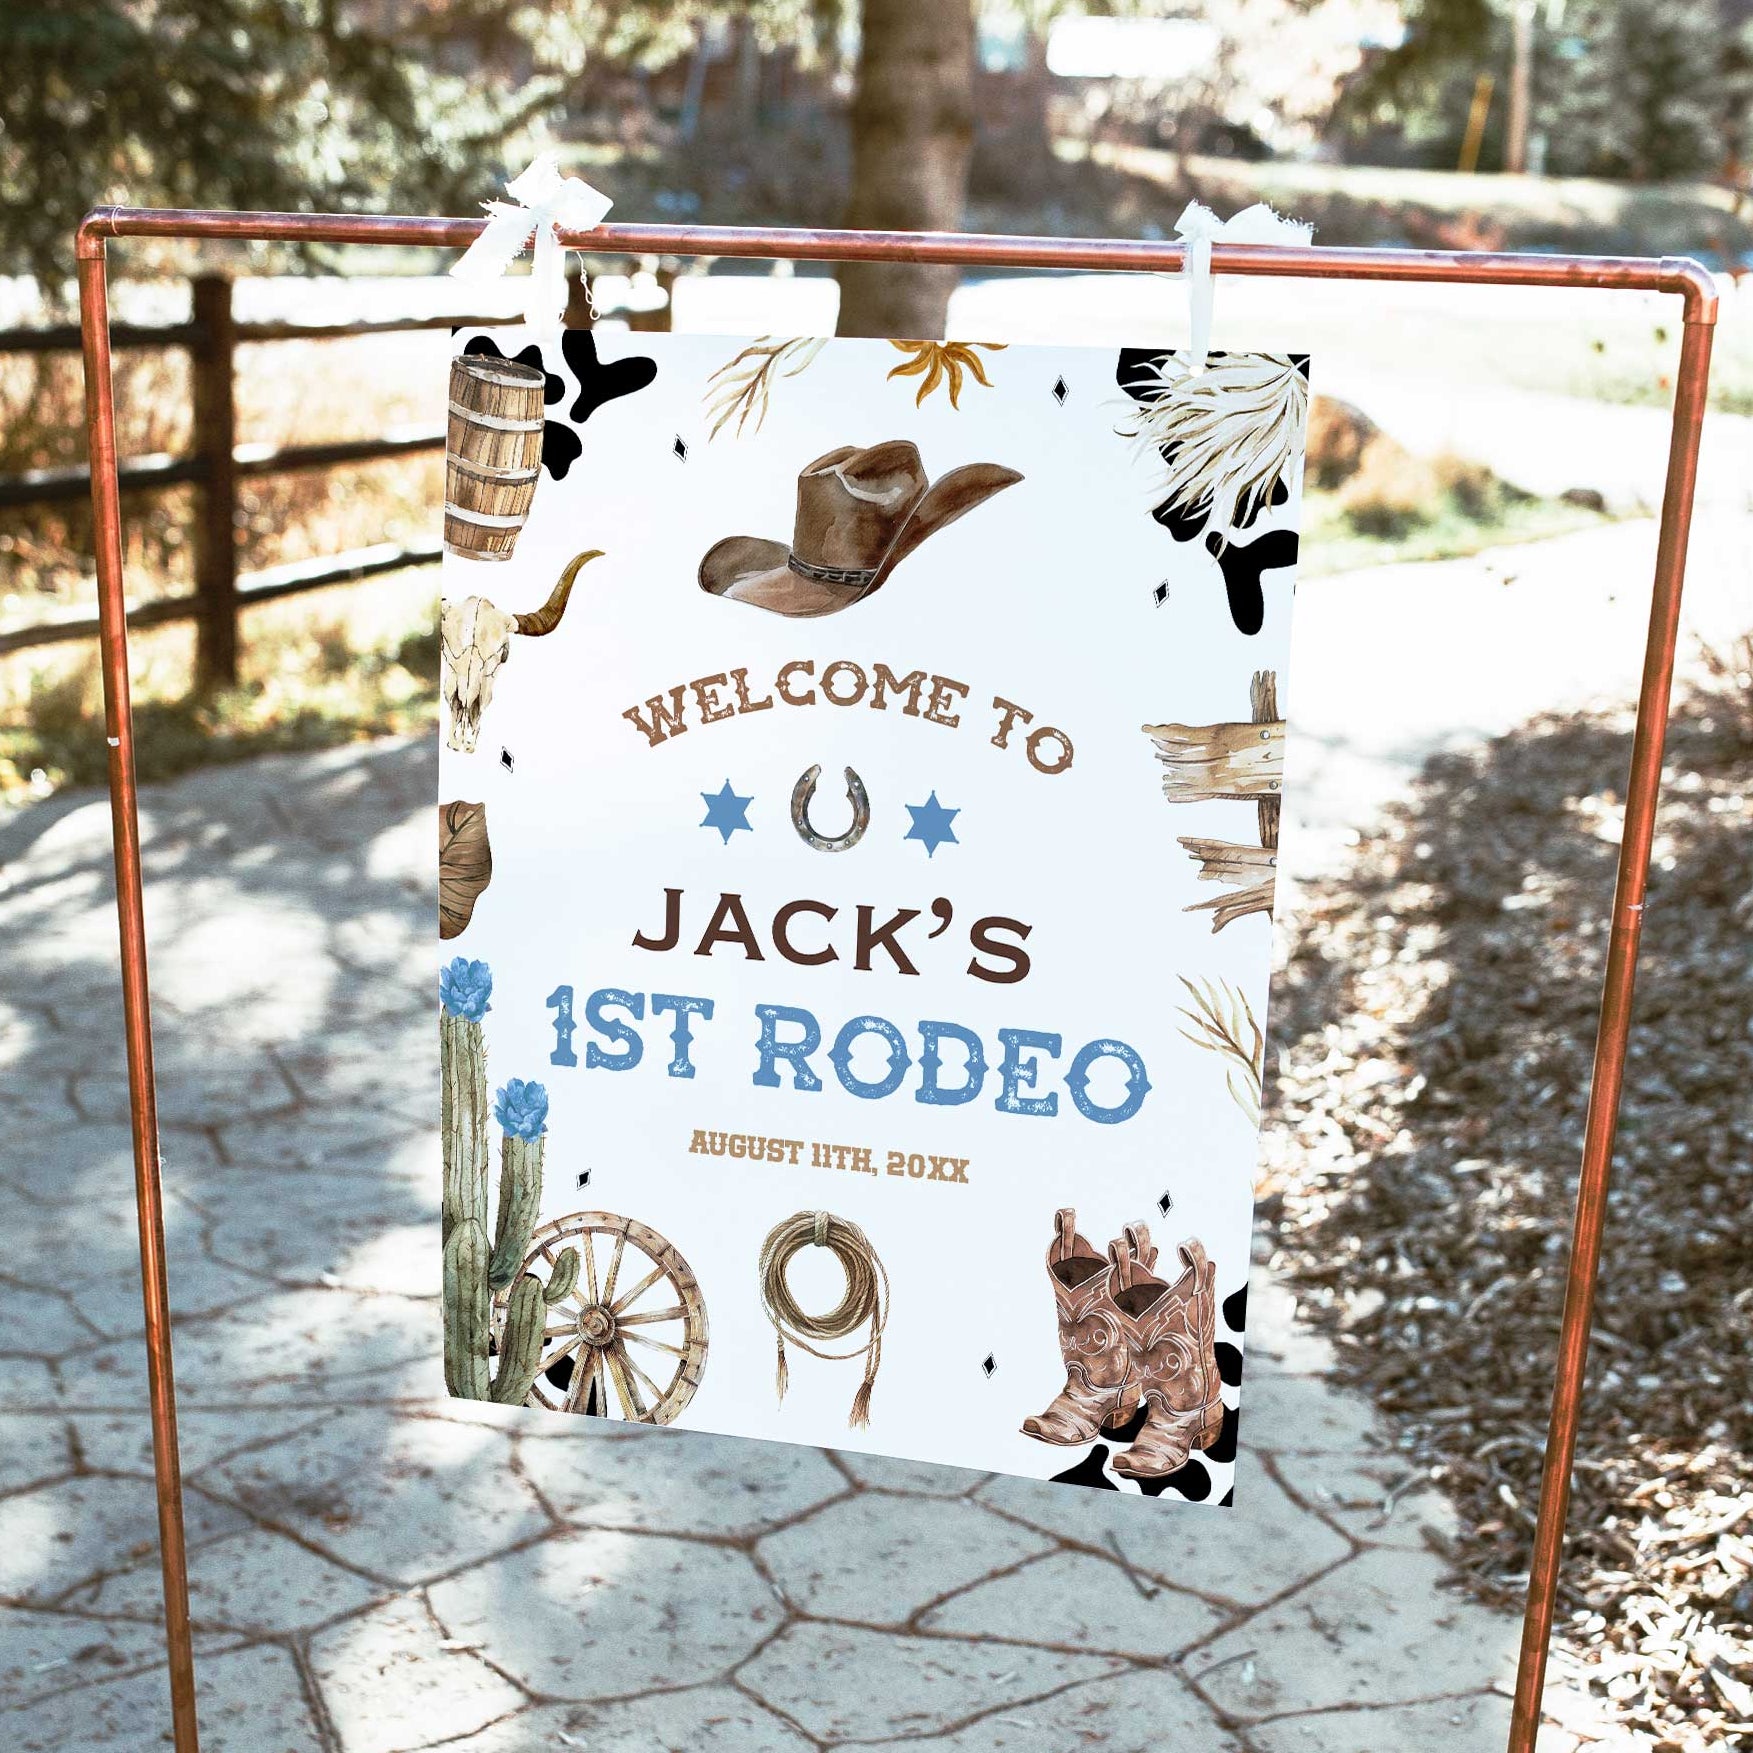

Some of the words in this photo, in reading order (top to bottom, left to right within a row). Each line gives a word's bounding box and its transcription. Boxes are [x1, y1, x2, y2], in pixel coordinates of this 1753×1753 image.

[621, 659, 971, 749] WELCOME
[989, 695, 1075, 776] TO
[545, 984, 716, 1080] 1ST
[751, 1002, 1154, 1126] RODEO
[688, 1128, 805, 1166] AUGUST
[810, 1142, 879, 1177] 11TH,
[885, 1150, 971, 1185] 20XX
